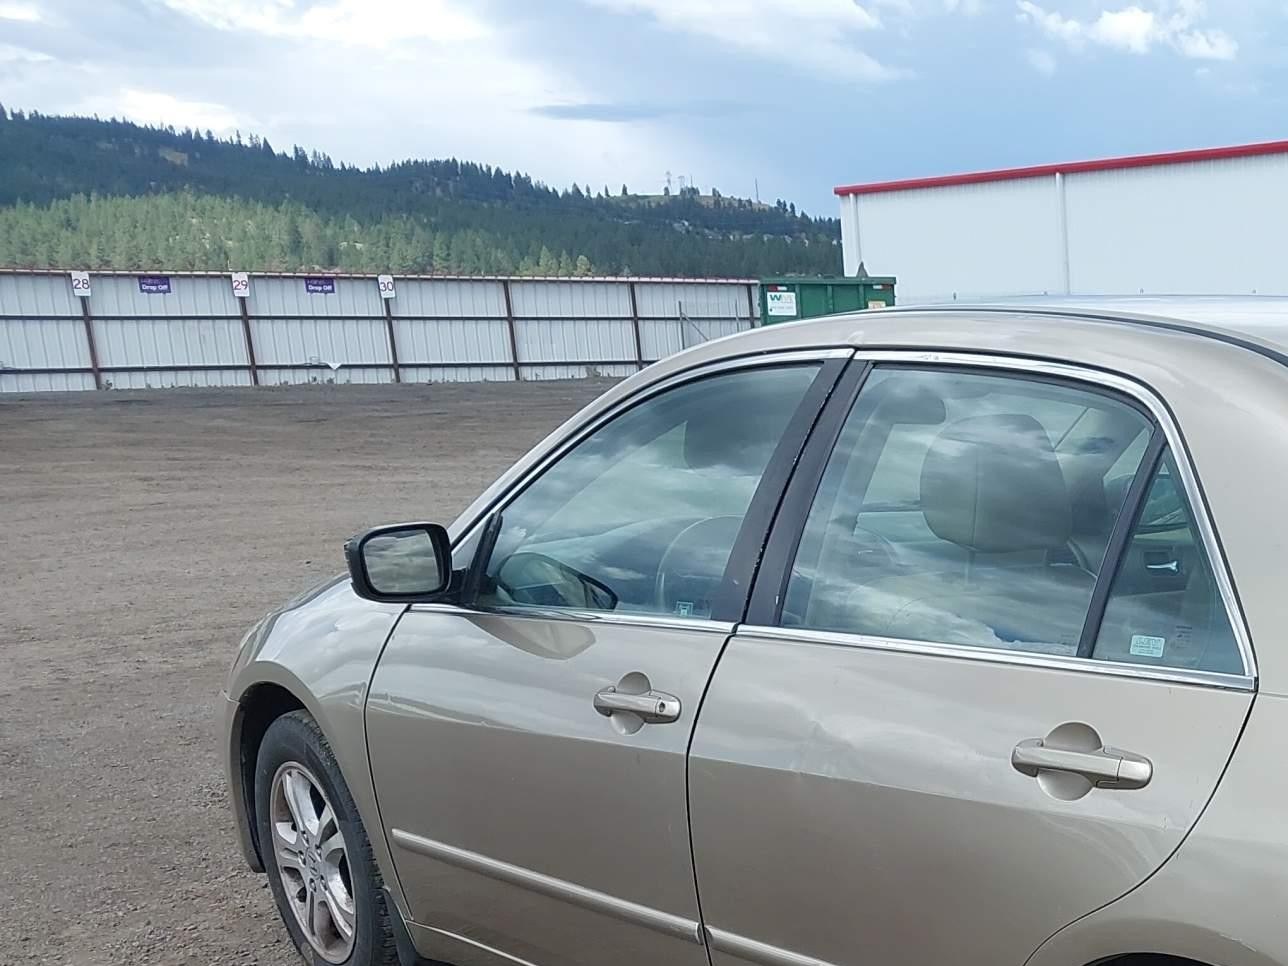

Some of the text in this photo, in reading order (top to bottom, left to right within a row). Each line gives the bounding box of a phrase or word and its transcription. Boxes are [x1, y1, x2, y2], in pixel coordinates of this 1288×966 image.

[73, 278, 90, 289] 28
[233, 279, 248, 290] 29
[380, 281, 394, 292] 30
